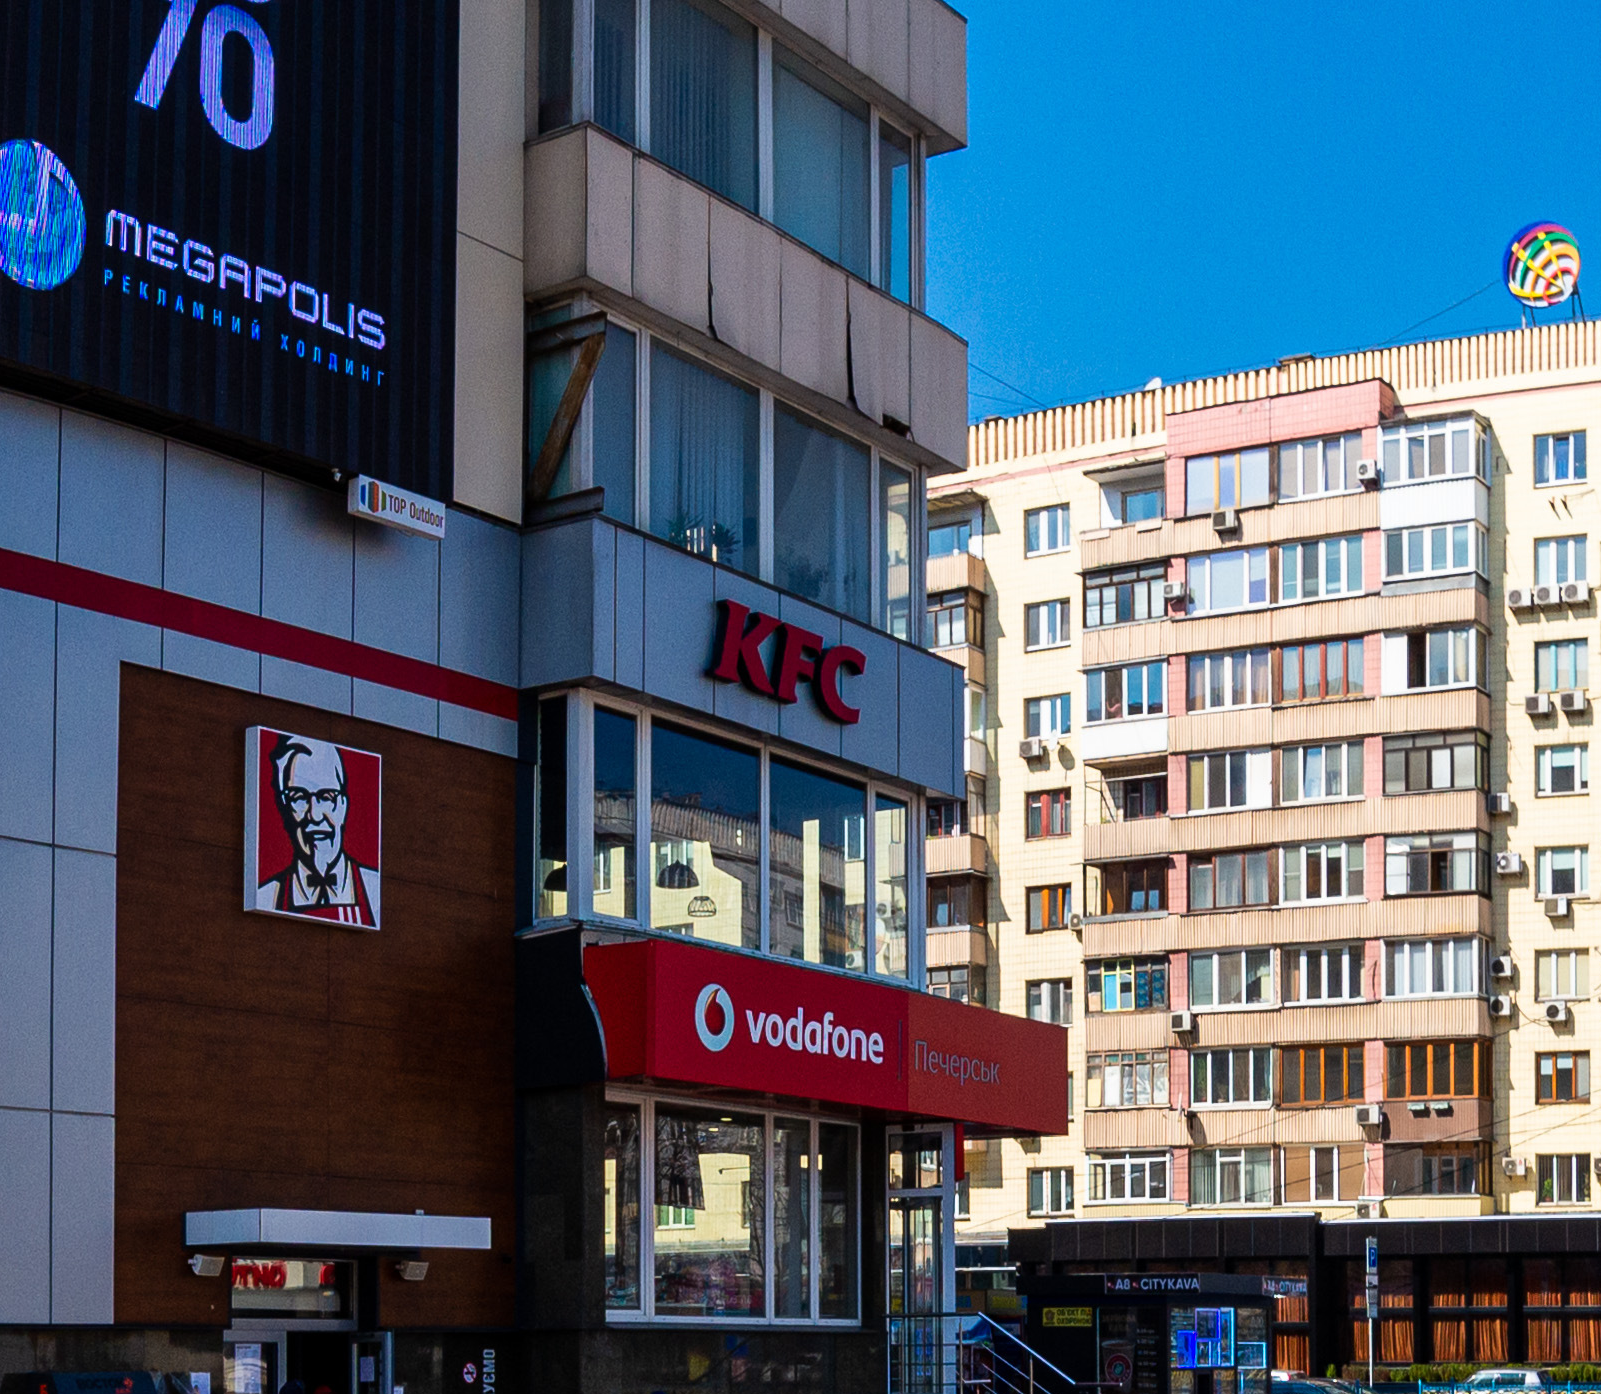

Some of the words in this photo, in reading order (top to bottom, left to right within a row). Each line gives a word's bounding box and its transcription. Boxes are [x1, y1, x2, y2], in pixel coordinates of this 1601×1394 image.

[104, 209, 386, 350] MEGAPOLIS
[103, 268, 261, 342] РЕКЛАМНИЙ
[280, 333, 386, 387] ХОЛДИНГ
[387, 494, 407, 515] TOP
[409, 501, 444, 529] Outdoor
[706, 599, 867, 726] KFC
[745, 1006, 884, 1065] vodafone
[914, 1040, 1000, 1086] Печерськ
[1114, 1275, 1131, 1291] A8
[1140, 1274, 1199, 1291] CITYKAVA
